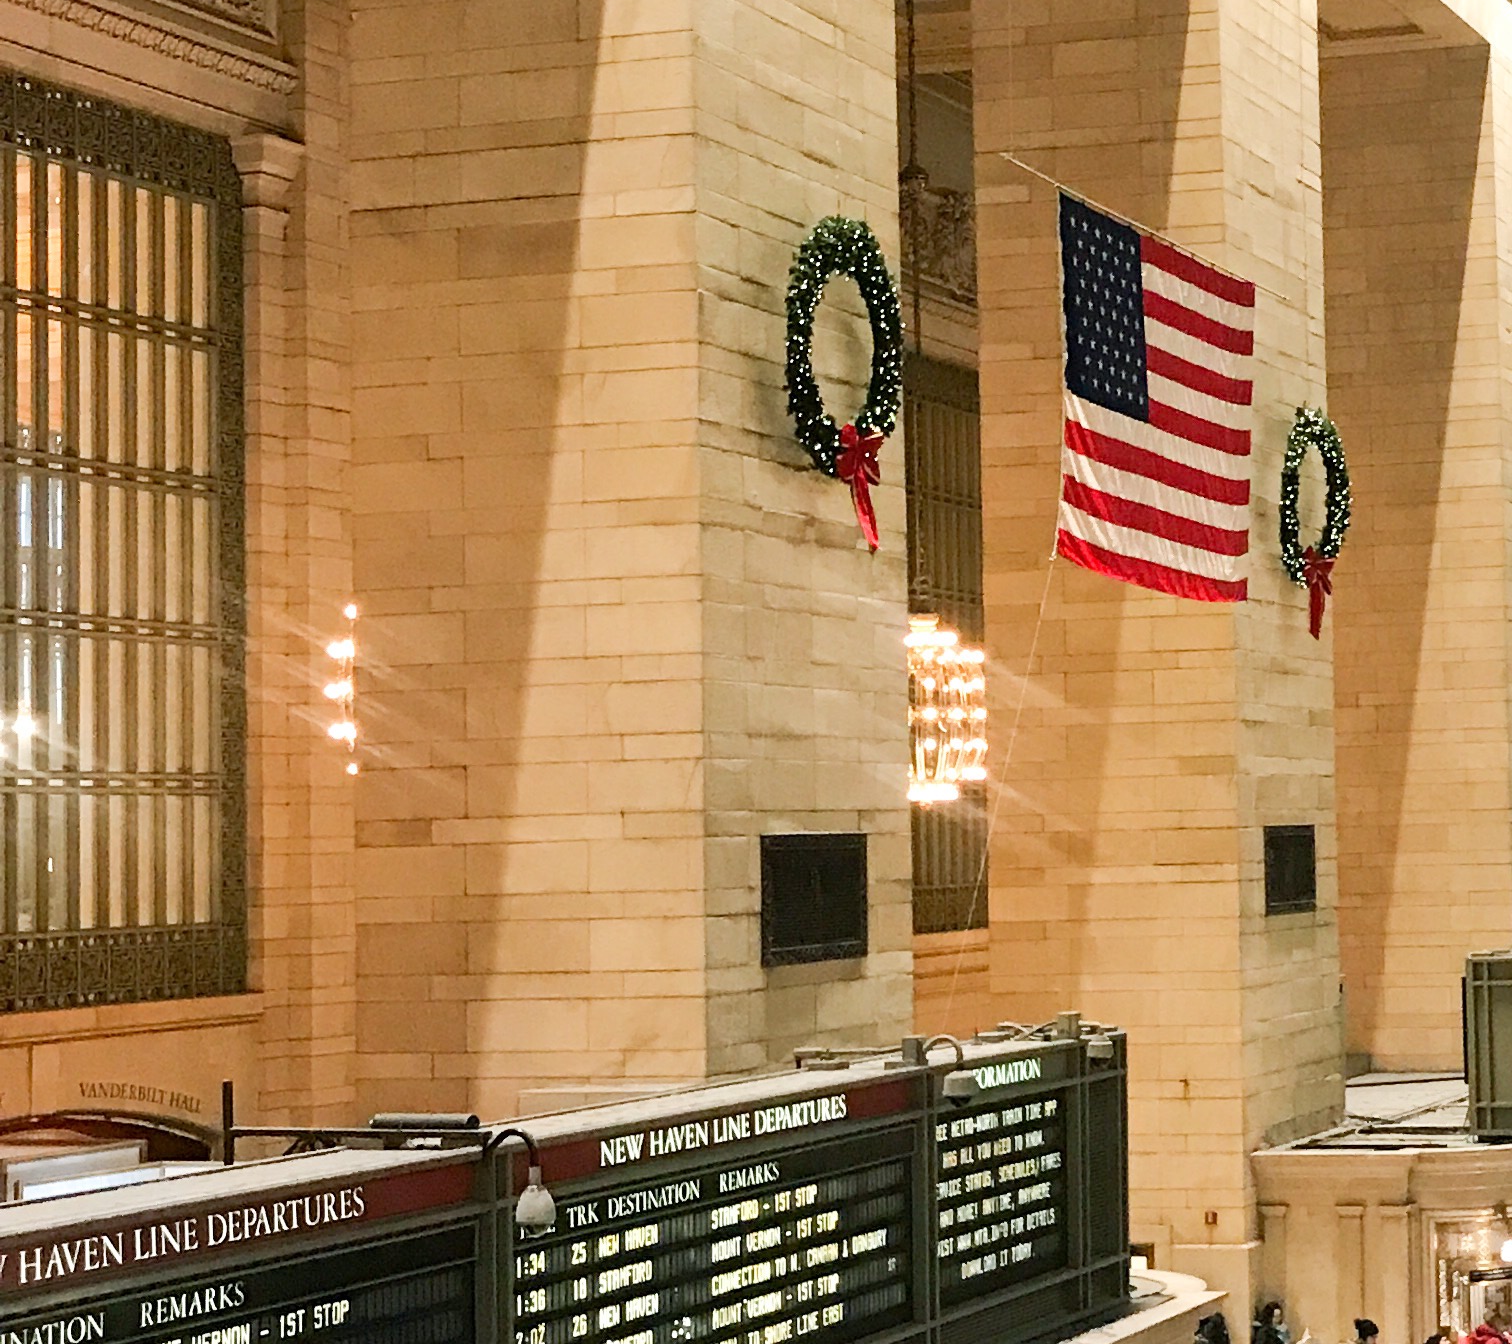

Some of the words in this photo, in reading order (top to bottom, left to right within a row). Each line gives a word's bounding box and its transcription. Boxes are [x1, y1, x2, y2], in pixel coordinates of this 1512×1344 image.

[78, 1081, 168, 1106] VANDERBILT
[169, 1091, 202, 1114] HALL
[973, 1058, 1041, 1090] ORMATION
[600, 1133, 644, 1167] NEW
[649, 1121, 709, 1157] HAVEN
[713, 1113, 751, 1143] LINE
[754, 1093, 847, 1136] DEPARTURES
[566, 1201, 600, 1229] TRK
[607, 1178, 701, 1220] DESTINATION
[719, 1160, 780, 1194] REMARKS
[18, 1232, 124, 1286] HAVEN
[133, 1217, 199, 1261] LINE
[207, 1185, 366, 1247] DEPARTURES
[516, 1250, 546, 1279] 1:34
[571, 1241, 588, 1265] 25
[598, 1233, 620, 1259] NEW
[624, 1223, 659, 1252] HAVEN
[711, 1199, 759, 1230] STAMFORD
[774, 1191, 791, 1213] 1ST
[795, 1184, 818, 1208] STOP
[516, 1288, 546, 1317] 1:36
[598, 1259, 653, 1294] STAMFORD
[711, 1236, 742, 1264] MOUNT
[746, 1226, 782, 1253] VERNON
[796, 1217, 813, 1239] 1ST
[816, 1210, 839, 1233] STOP
[572, 1313, 588, 1338] 26
[598, 1303, 621, 1330] NEW
[625, 1292, 659, 1321] HAVEN
[711, 1261, 771, 1297] CONNECTION
[775, 1256, 787, 1277] TO
[806, 1242, 839, 1268] CANAAN
[851, 1228, 887, 1255] DANBURY
[139, 1280, 245, 1328] REMARKS
[280, 1308, 306, 1339] 1ST
[313, 1299, 350, 1328] STOP
[712, 1302, 742, 1330] MOUNT
[746, 1291, 782, 1319] VERNON
[797, 1280, 814, 1302] 1ST
[817, 1273, 840, 1297] STOP
[796, 1310, 819, 1336] LINE
[822, 1302, 844, 1326] EAST
